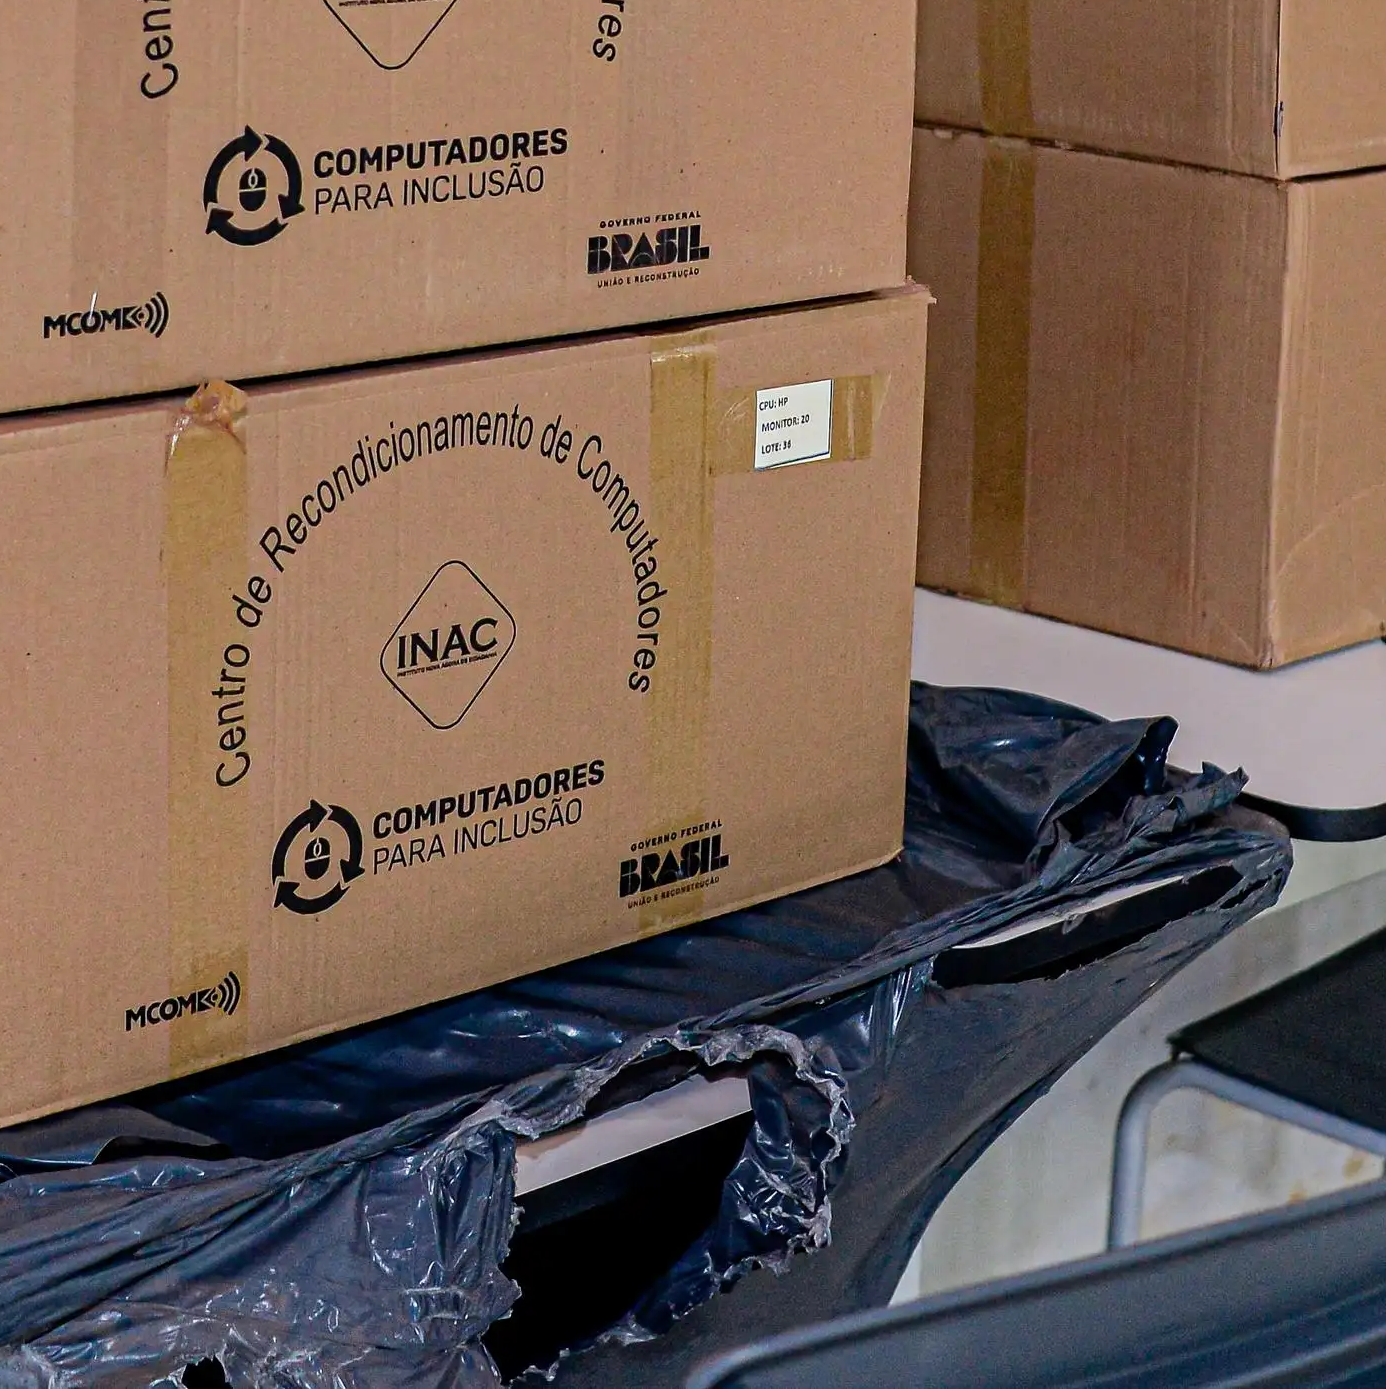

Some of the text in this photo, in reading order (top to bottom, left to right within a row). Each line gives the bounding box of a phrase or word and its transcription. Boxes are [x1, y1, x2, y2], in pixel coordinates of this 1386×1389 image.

[313, 128, 568, 178] COMPUTADORES
[314, 162, 544, 215] PARA INCLUSÃO
[600, 211, 701, 229] GOVERNO FEDERAL
[587, 225, 709, 274] BRASIL
[597, 278, 624, 288] UNIÃO
[634, 267, 700, 284] RECONSTRUÇÃO
[759, 397, 789, 411] CPU: HP
[761, 414, 810, 433] MONITOR: 20
[761, 441, 781, 455] LOTE:
[212, 404, 668, 787] Centro de Recondicionamento de Computadores
[397, 618, 498, 669] INAC
[372, 759, 605, 839] COMPUTADORES
[372, 797, 582, 875] PARA INCLUSÃO
[630, 819, 723, 852] GOVERNO FEDERAL
[619, 834, 729, 898] BRASIL
[627, 896, 651, 909] UNIÃO
[661, 876, 720, 900] RECONSTRUÇÃO
